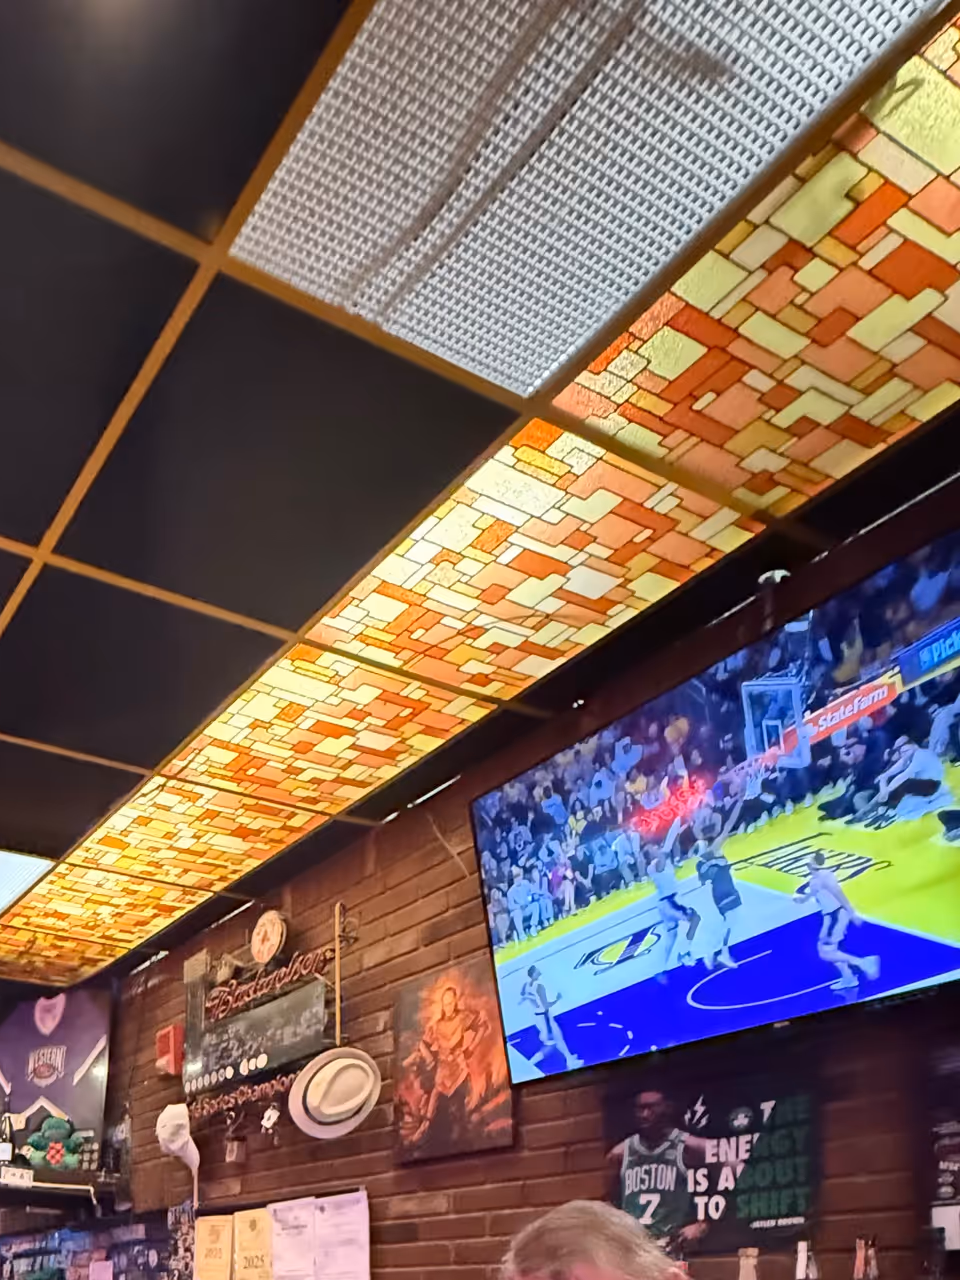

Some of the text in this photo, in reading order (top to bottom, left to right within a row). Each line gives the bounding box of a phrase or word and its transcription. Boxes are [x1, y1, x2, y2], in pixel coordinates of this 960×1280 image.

[625, 1163, 677, 1196] BOSTON
[687, 1168, 708, 1192] IS
[638, 1193, 661, 1224] 7
[694, 1195, 726, 1220] TO
[243, 1254, 265, 1269] 2025
